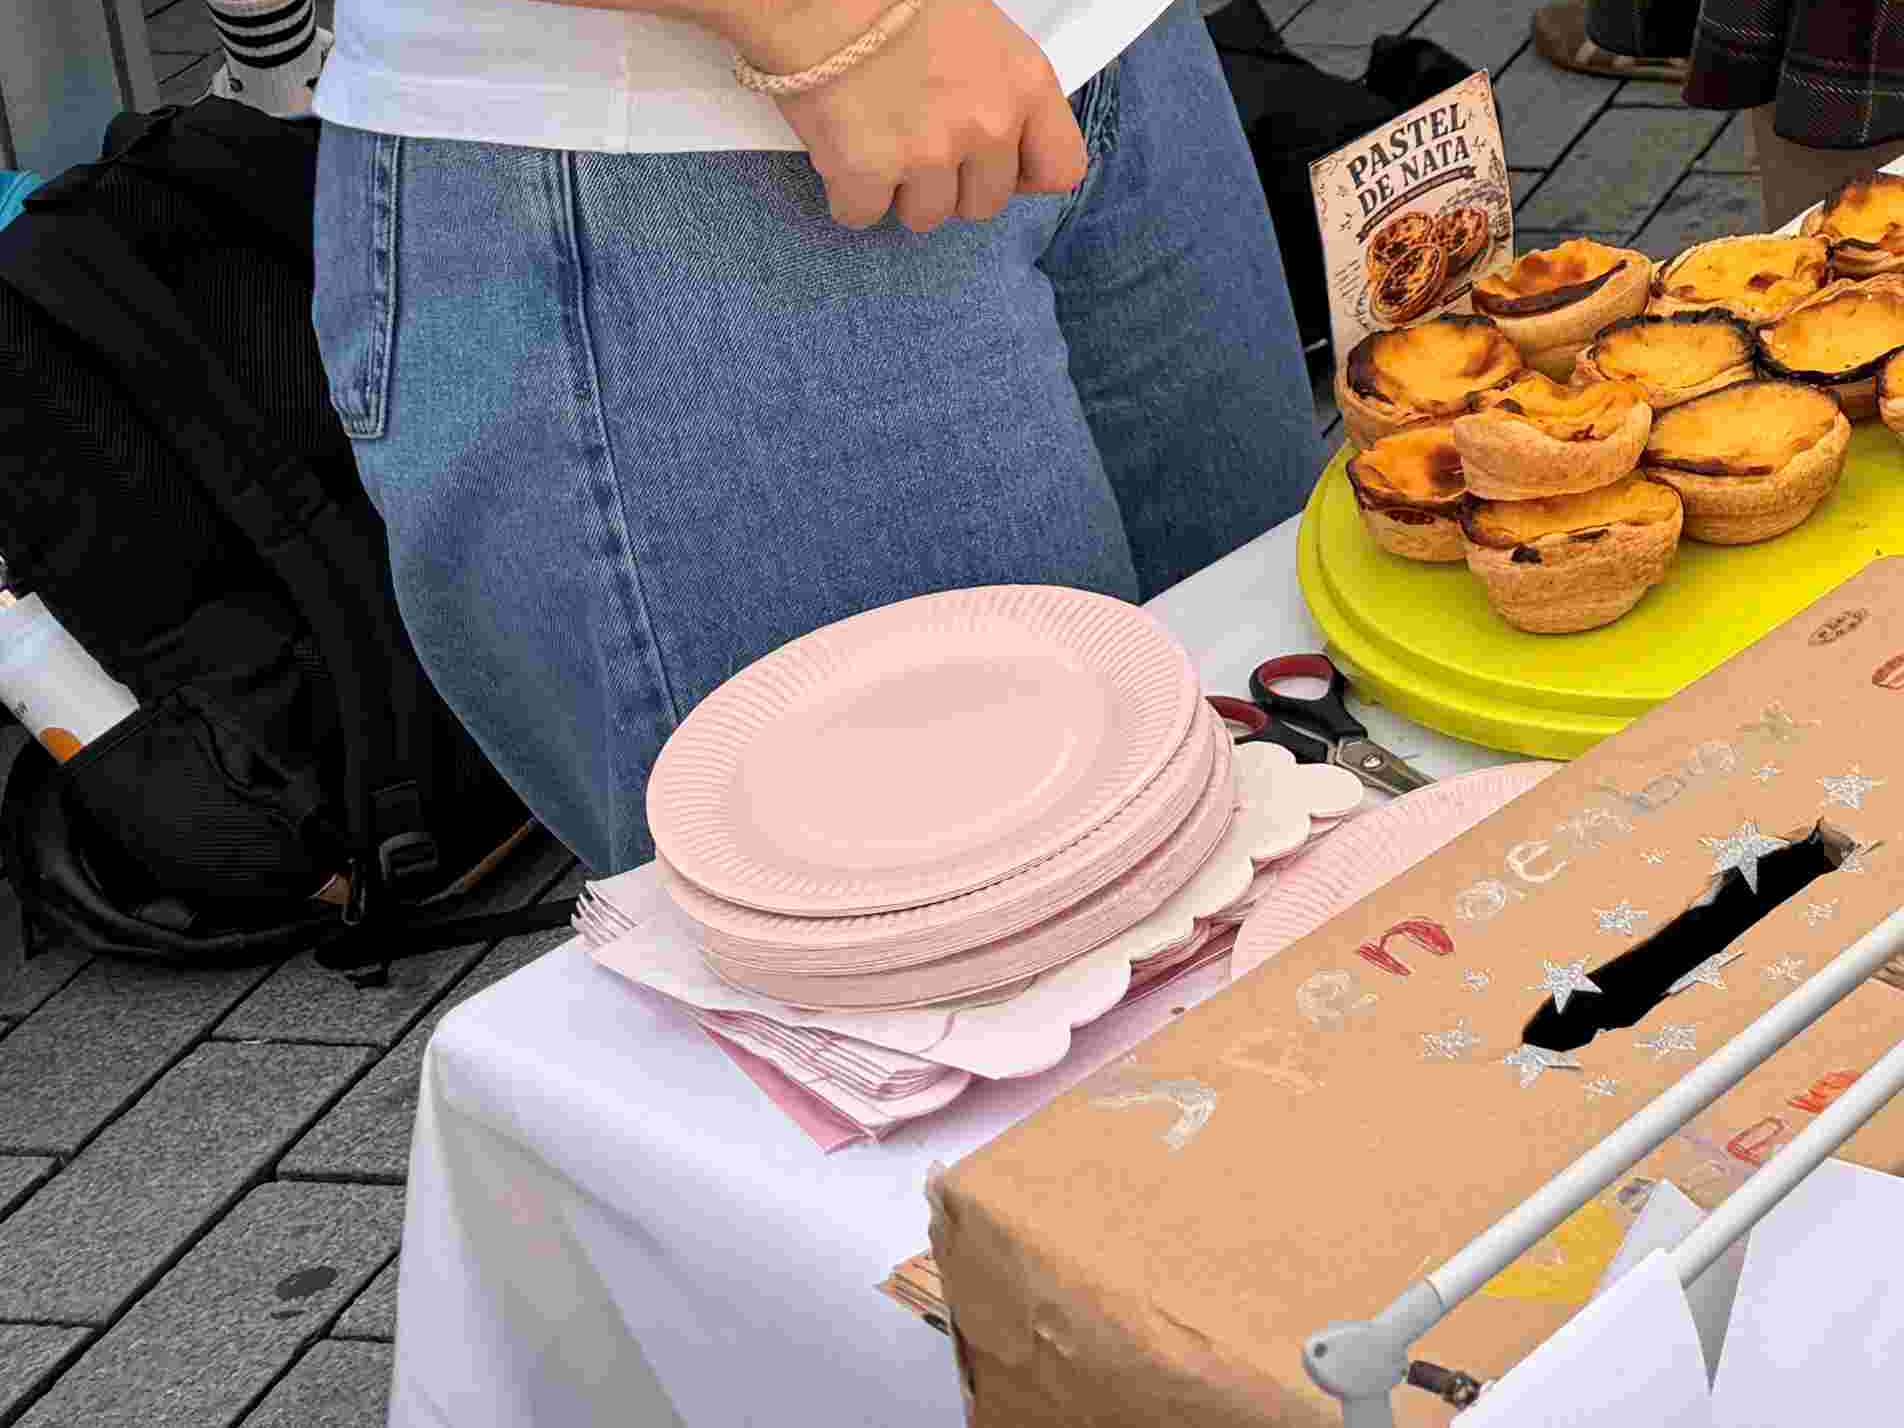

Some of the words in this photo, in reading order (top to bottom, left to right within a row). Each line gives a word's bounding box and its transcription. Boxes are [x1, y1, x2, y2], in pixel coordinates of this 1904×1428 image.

[1346, 102, 1467, 188] PASTEL
[1357, 173, 1394, 217] DE
[1400, 134, 1472, 184] NATA
